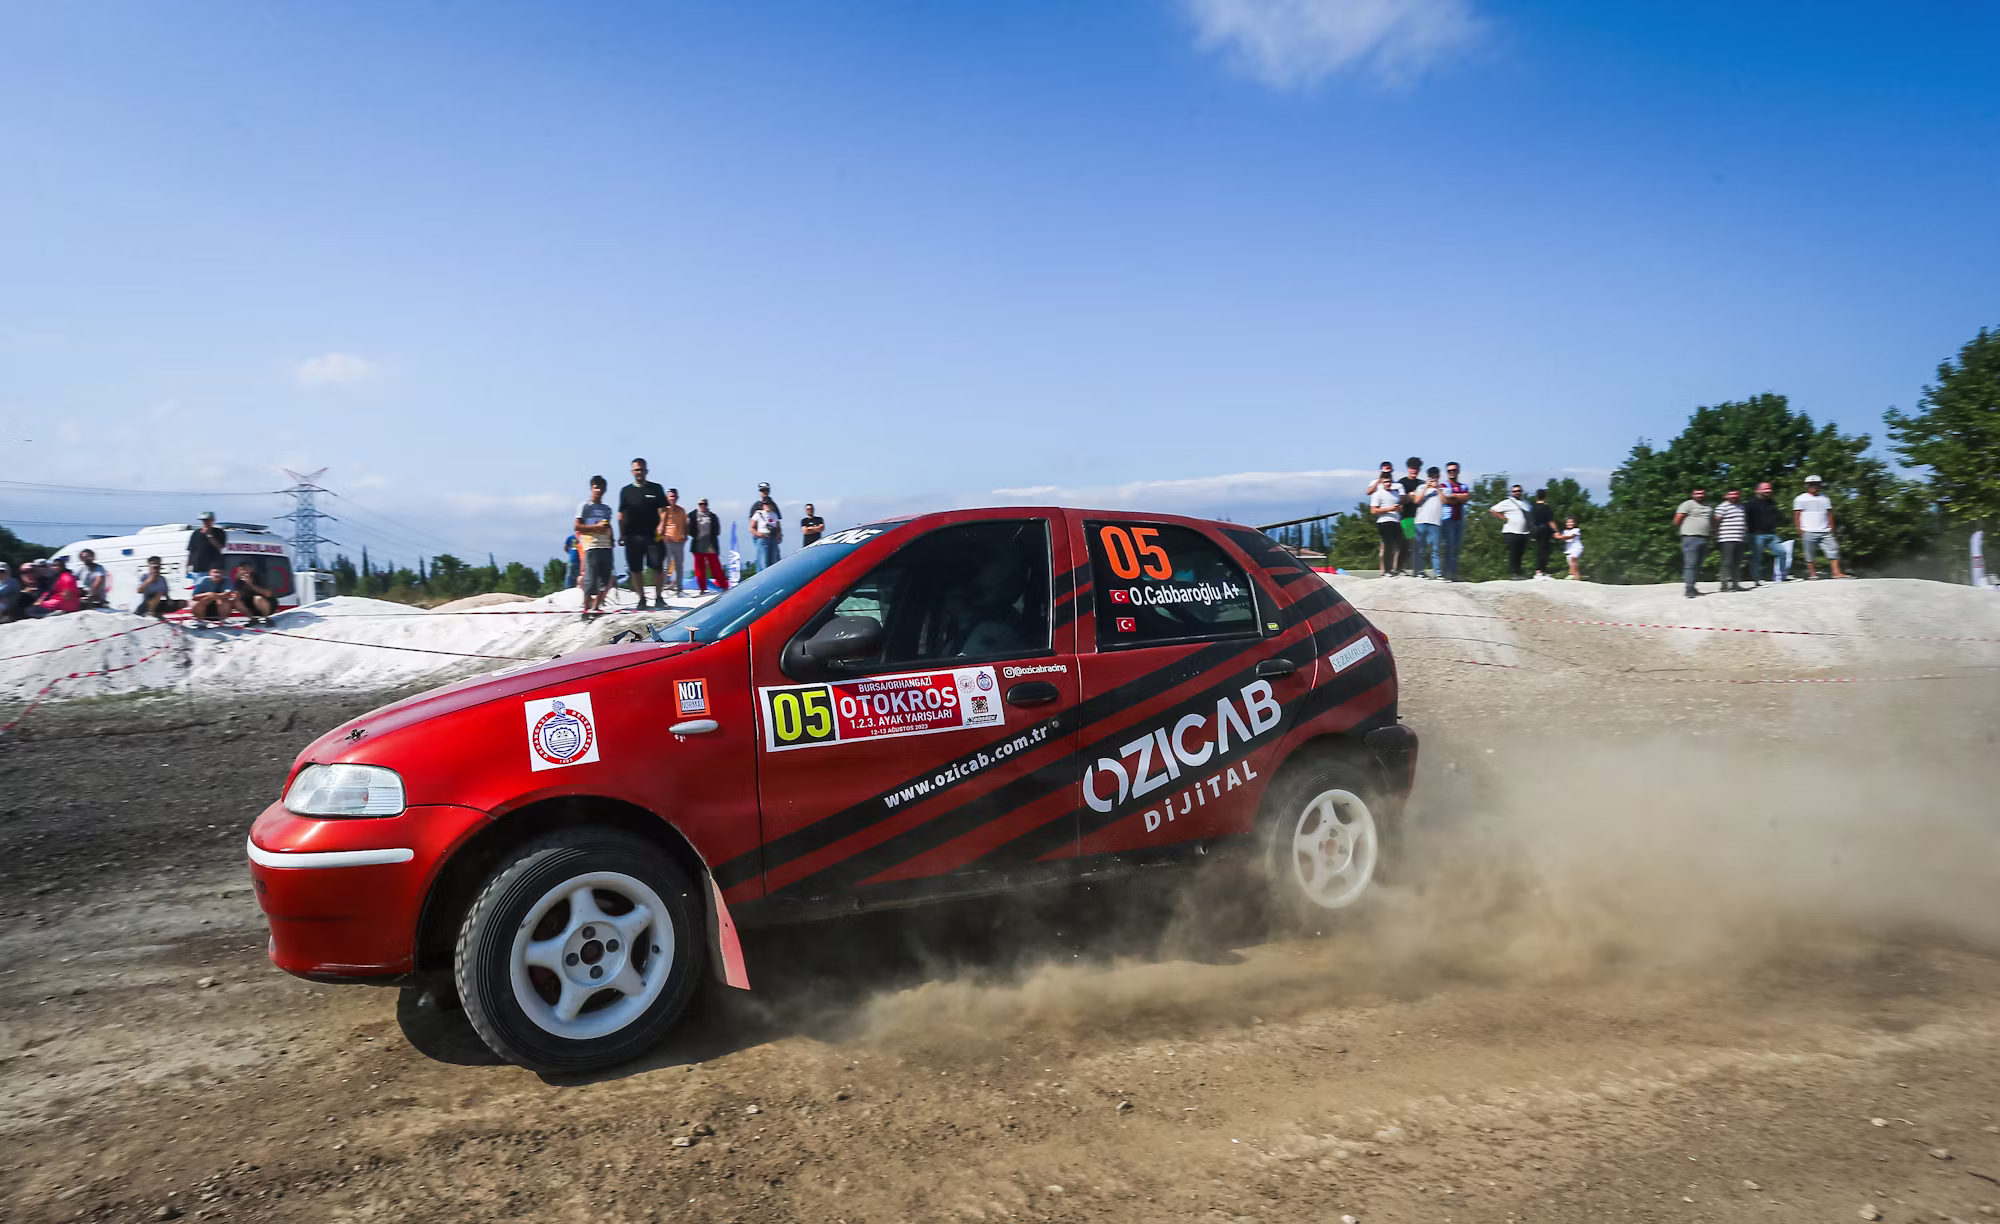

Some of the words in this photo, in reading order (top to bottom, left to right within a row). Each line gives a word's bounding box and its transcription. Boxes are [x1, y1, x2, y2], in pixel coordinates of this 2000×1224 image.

[1100, 526, 1173, 580] 05
[1129, 582, 1222, 606] O.Cabbaroğlu
[1223, 581, 1240, 600] A+
[1332, 640, 1373, 670] SEZBURGER
[678, 681, 703, 700] NOT
[839, 686, 957, 718] OTOKROS
[773, 690, 832, 741] 05
[850, 719, 877, 729] 1.2.3.
[878, 712, 903, 727] AYAK
[906, 709, 953, 723] YARIŞLARI
[915, 723, 928, 731] 2023
[1083, 679, 1282, 813] OZICAB
[884, 725, 1047, 808] www.ozicab.com.tr
